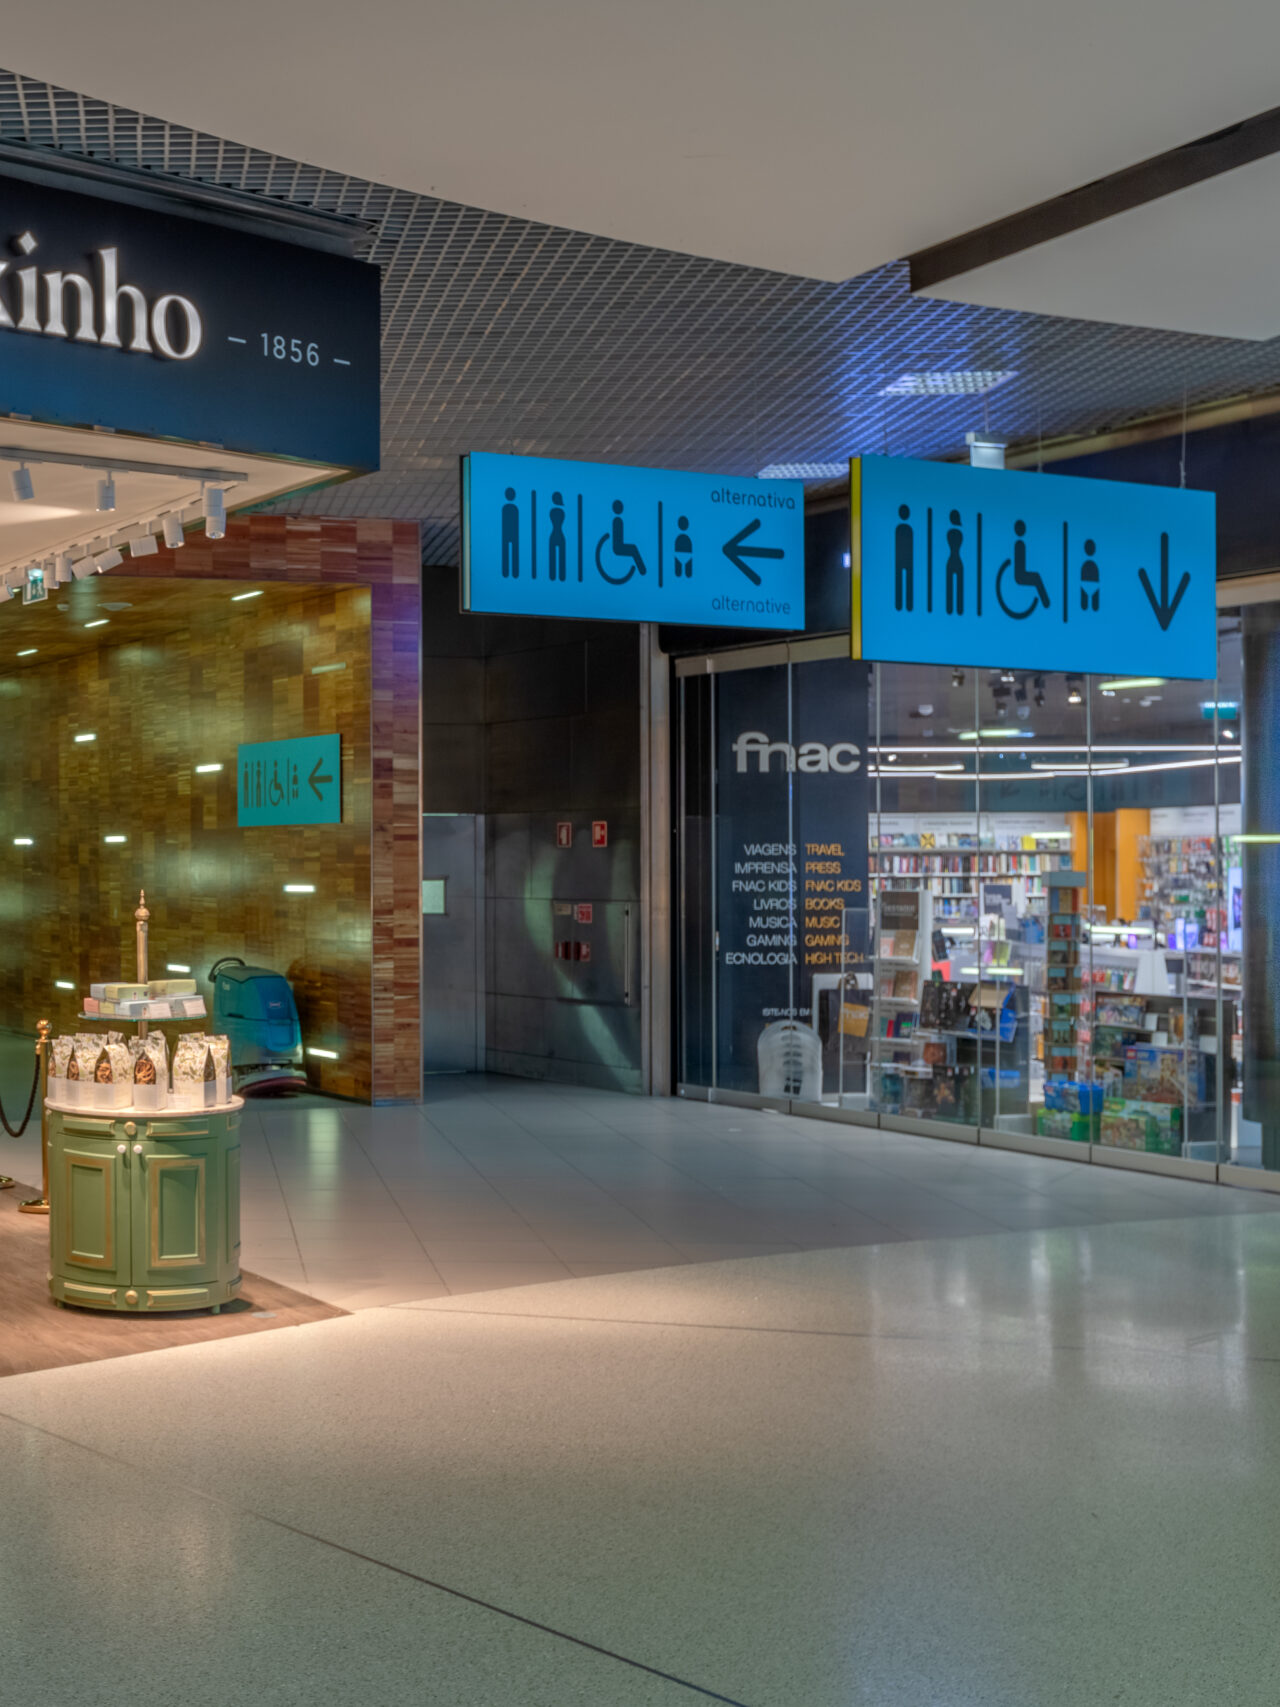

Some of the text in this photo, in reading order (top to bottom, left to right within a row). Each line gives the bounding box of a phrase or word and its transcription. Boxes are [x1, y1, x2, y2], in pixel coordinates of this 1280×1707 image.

[260, 332, 320, 367] 1856
[710, 487, 796, 510] alternativa
[711, 594, 792, 615] alternative
[731, 730, 861, 773] fnac
[743, 843, 797, 856] VIAGENS
[805, 843, 845, 856] TRAVEL
[734, 862, 798, 874] IMPRENSA
[805, 862, 841, 874] PRESS
[732, 880, 797, 892] FNAC KIDS
[805, 880, 862, 892] FNAC KIDS
[753, 898, 797, 911] LIVROS
[805, 898, 845, 911] BOOKS
[805, 916, 840, 928] MUSIC
[746, 934, 797, 947] GAMING
[805, 934, 850, 947] GAMING
[805, 952, 865, 965] HIGH TECH
